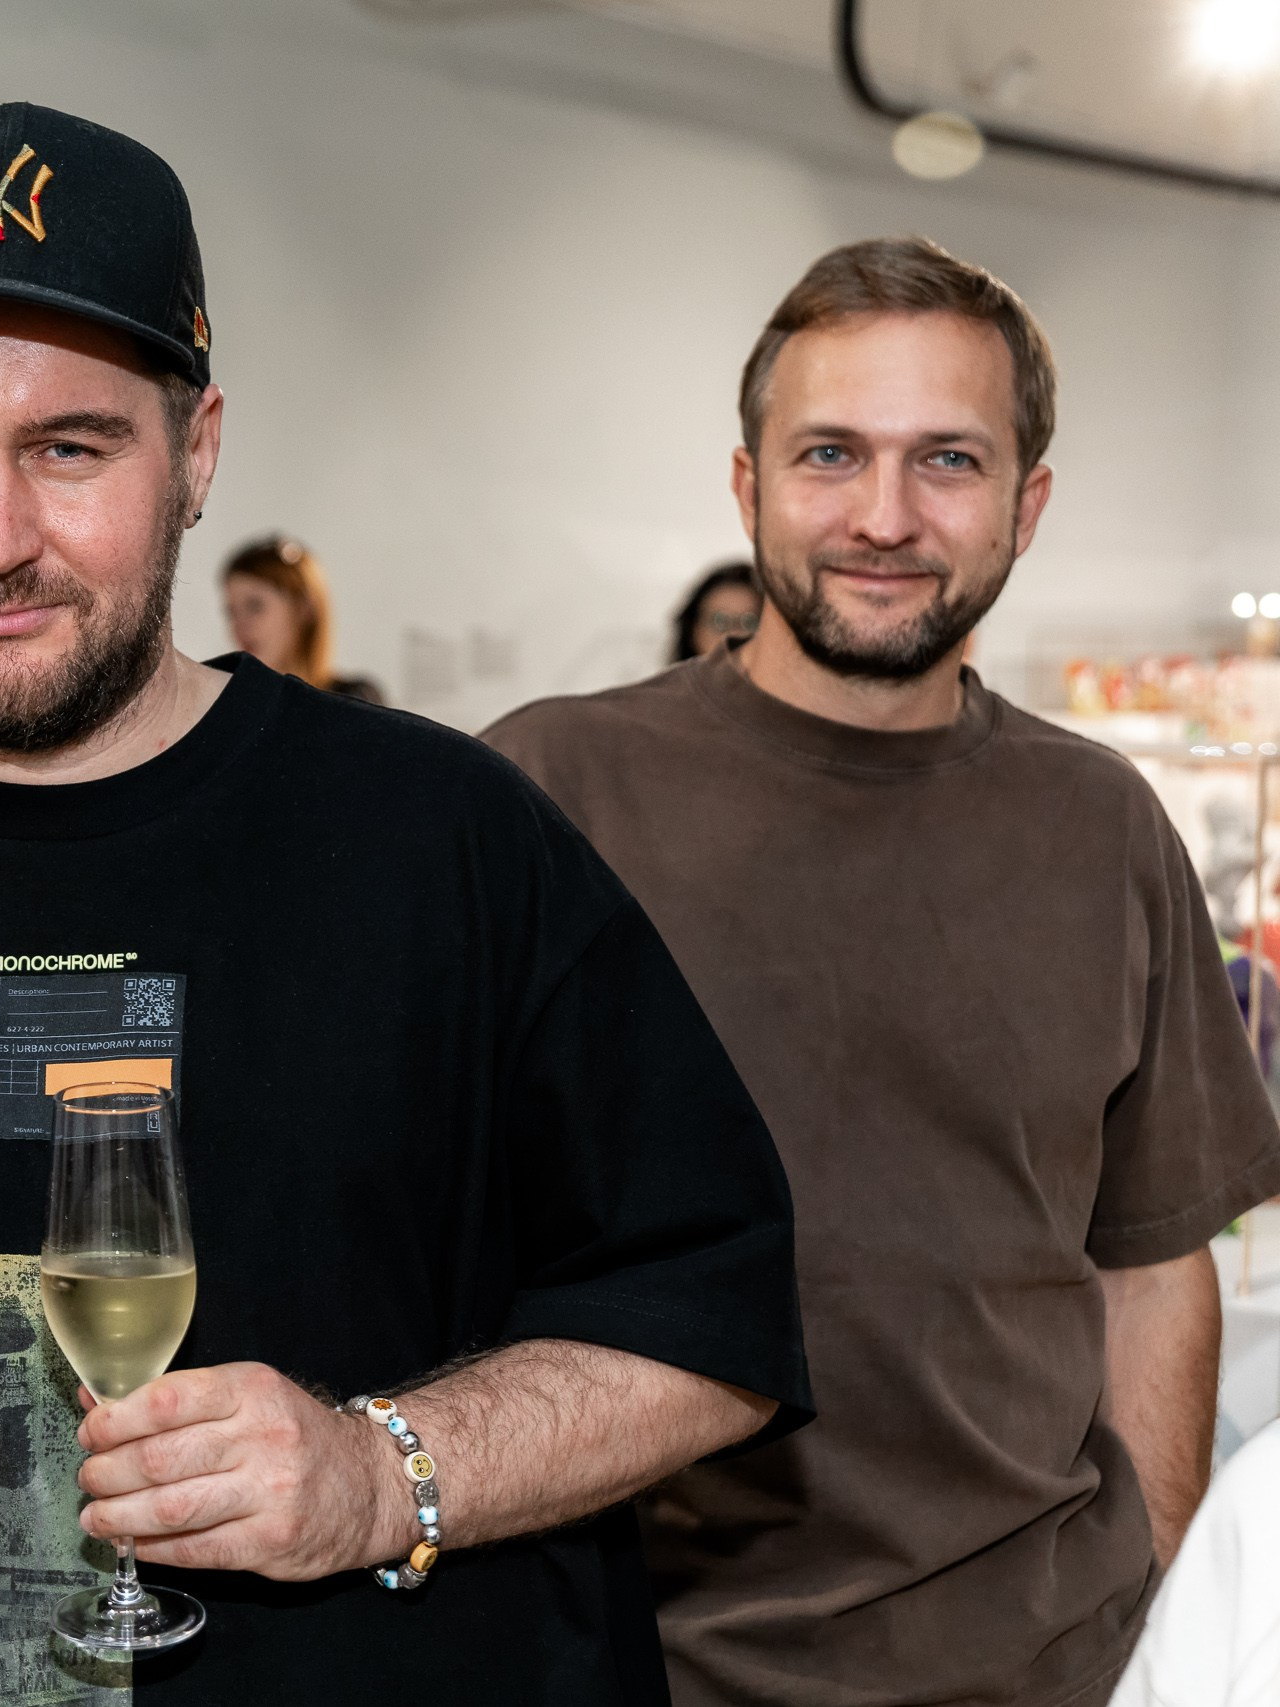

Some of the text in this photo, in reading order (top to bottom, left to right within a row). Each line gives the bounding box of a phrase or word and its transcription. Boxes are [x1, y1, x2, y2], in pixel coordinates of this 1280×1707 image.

[17, 1044, 53, 1053] URBAN
[54, 1040, 136, 1052] CONTEMPORARY
[138, 1039, 173, 1048] ARTIST
